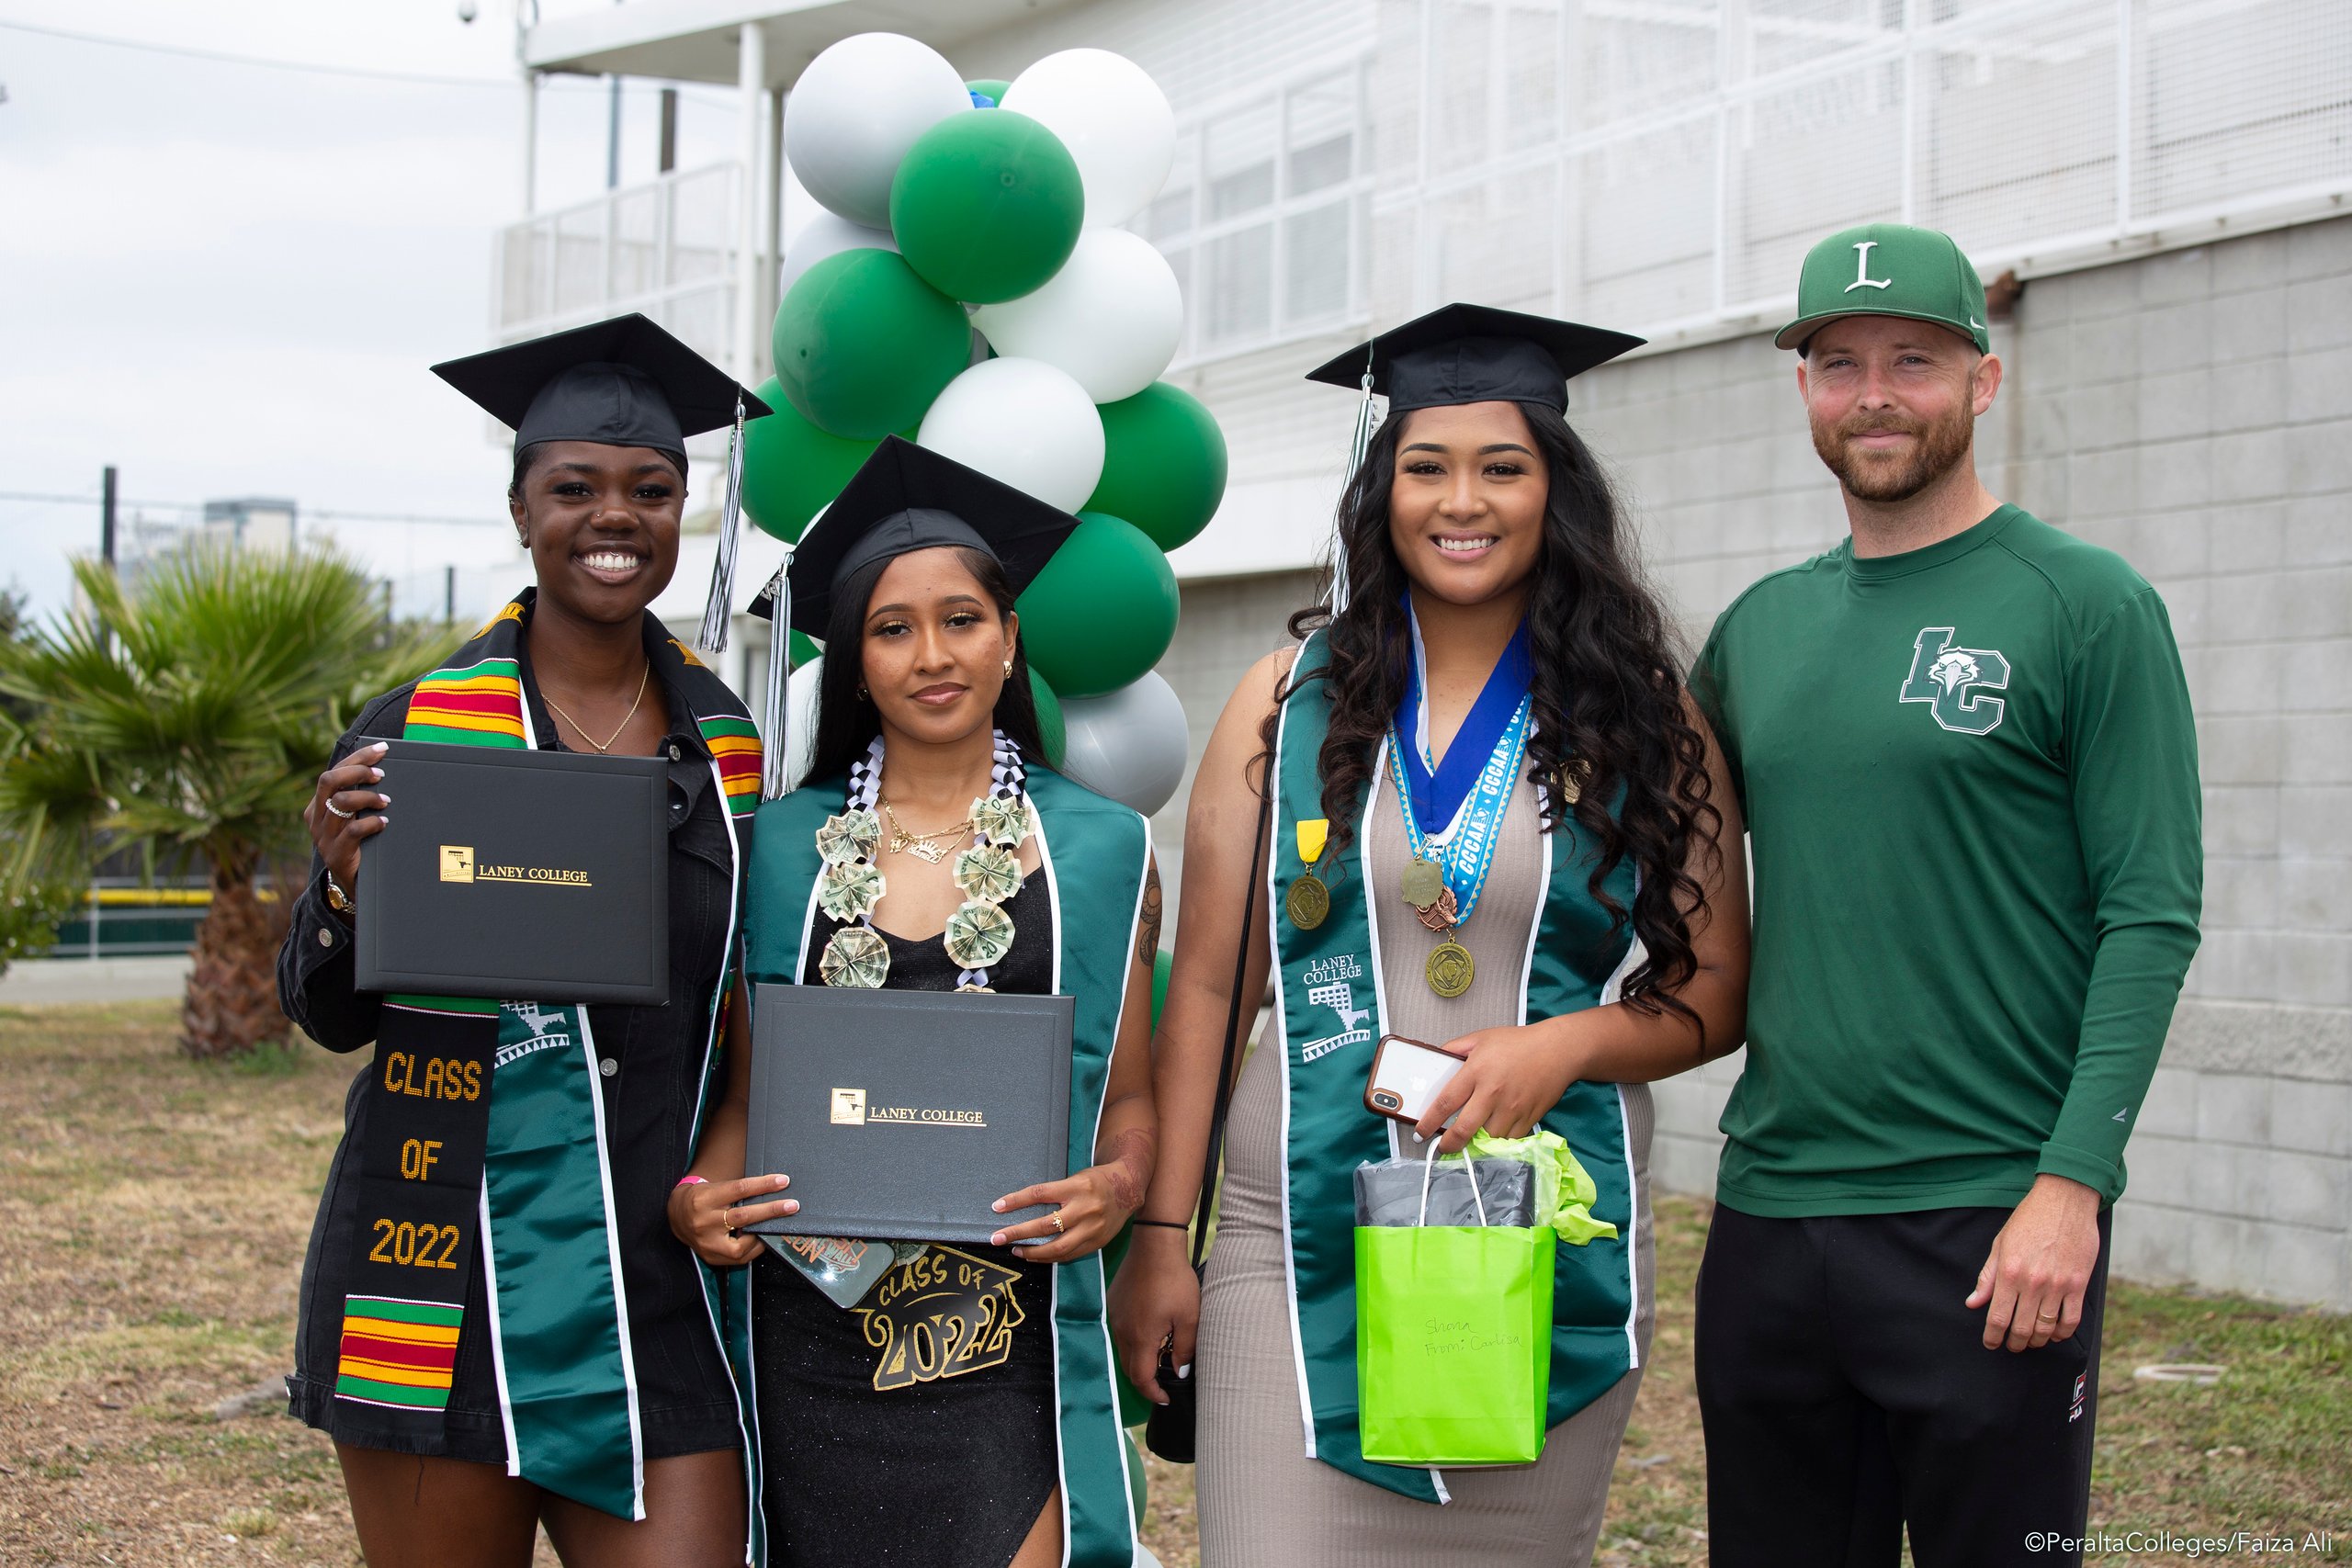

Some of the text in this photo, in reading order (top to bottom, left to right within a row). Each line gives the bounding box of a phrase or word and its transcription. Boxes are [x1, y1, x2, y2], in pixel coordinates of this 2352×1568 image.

[1844, 242, 1891, 293] L
[1899, 626, 2011, 736] LC
[1482, 747, 1509, 795] CCCAA
[480, 864, 588, 883] LANEY COLLEGE
[1459, 822, 1487, 875] CCCAA
[1303, 964, 1363, 985] COLLEGE
[1311, 954, 1354, 972] LANEY
[384, 1051, 482, 1101] CLASS
[870, 1107, 983, 1122] LANEY COLLEGE
[401, 1138, 443, 1181] OF
[369, 1218, 460, 1269] 2022
[879, 1254, 948, 1306] CLASS
[958, 1264, 986, 1290] OF
[864, 1282, 1012, 1391] 2022
